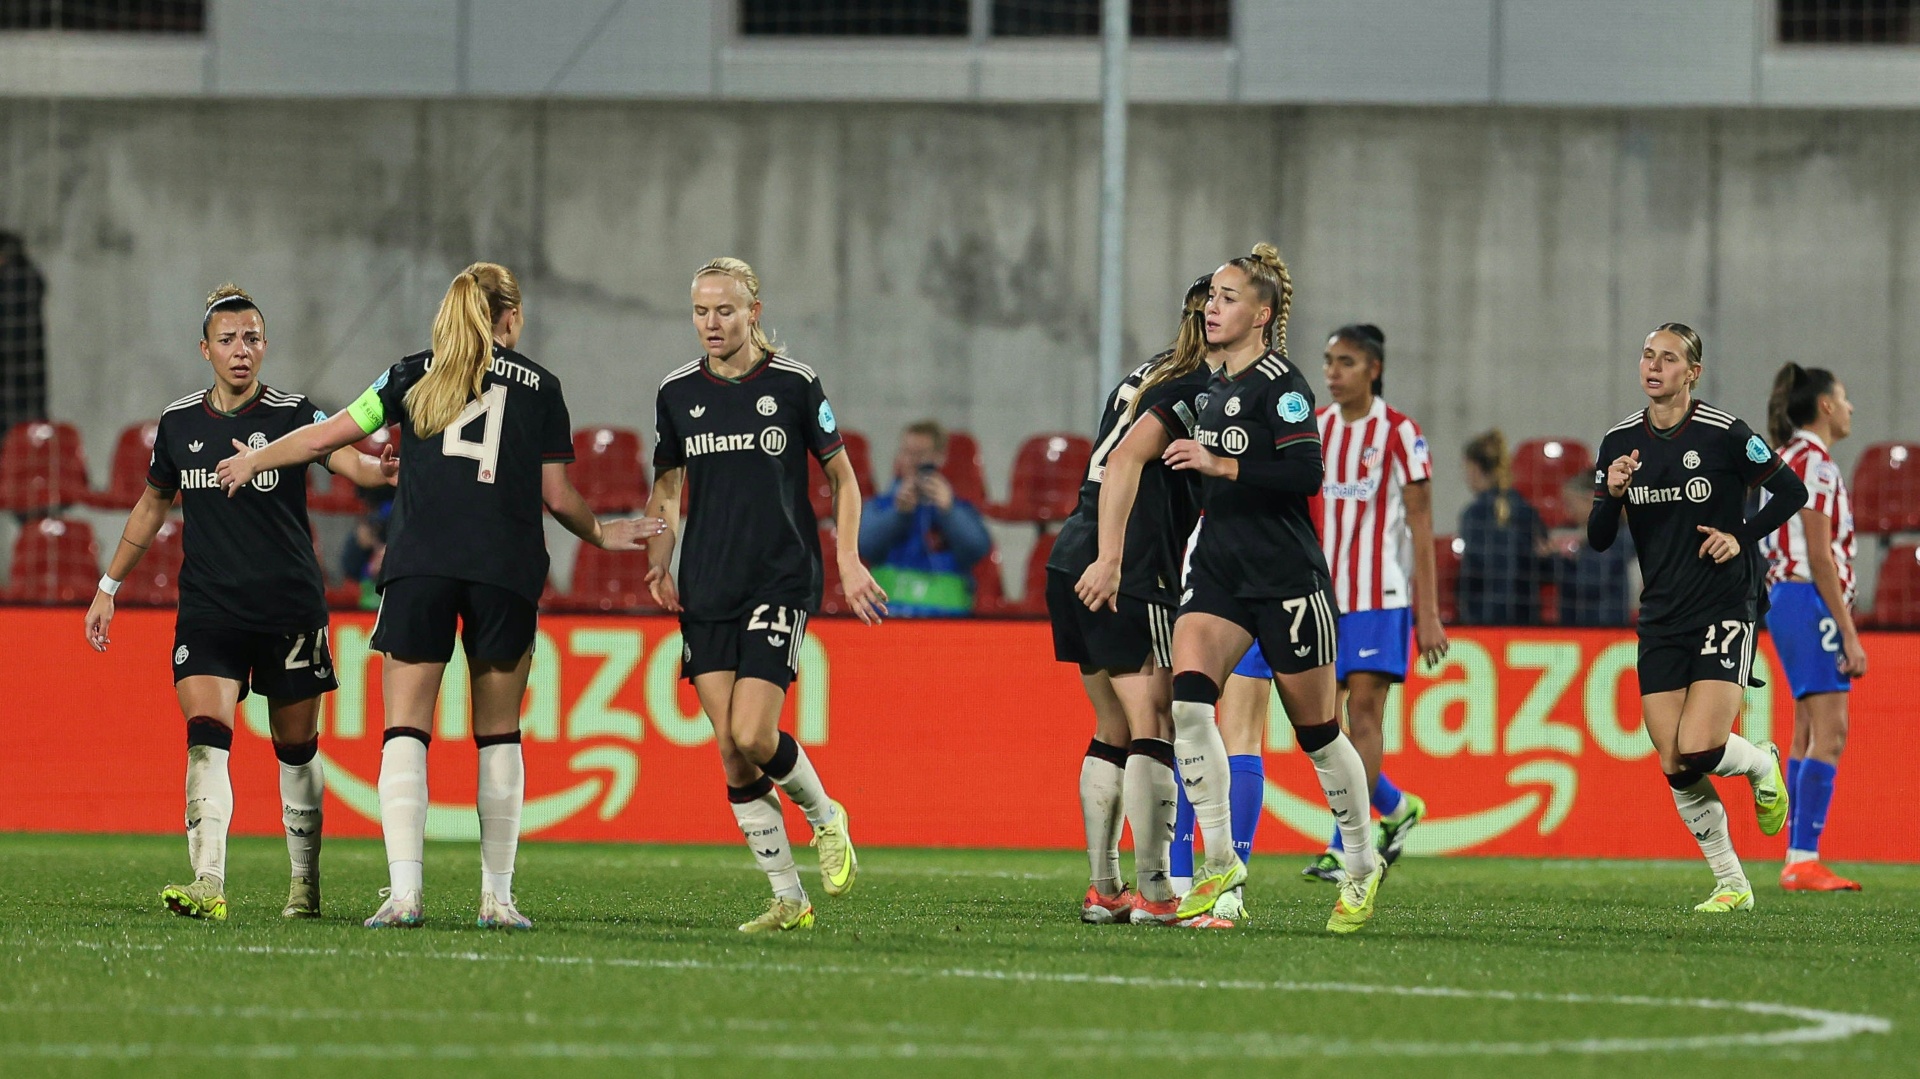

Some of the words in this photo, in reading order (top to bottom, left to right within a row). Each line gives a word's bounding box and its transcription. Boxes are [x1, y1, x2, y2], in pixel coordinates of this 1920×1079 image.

[442, 383, 508, 484] 4
[685, 433, 755, 458] Allianz
[180, 468, 246, 489] Allia
[1627, 486, 1683, 505] Allianz
[747, 604, 791, 633] 21
[1282, 598, 1307, 643] 7
[1700, 620, 1742, 655] 17
[1818, 616, 1840, 652] 2
[1177, 755, 1204, 766] CBM
